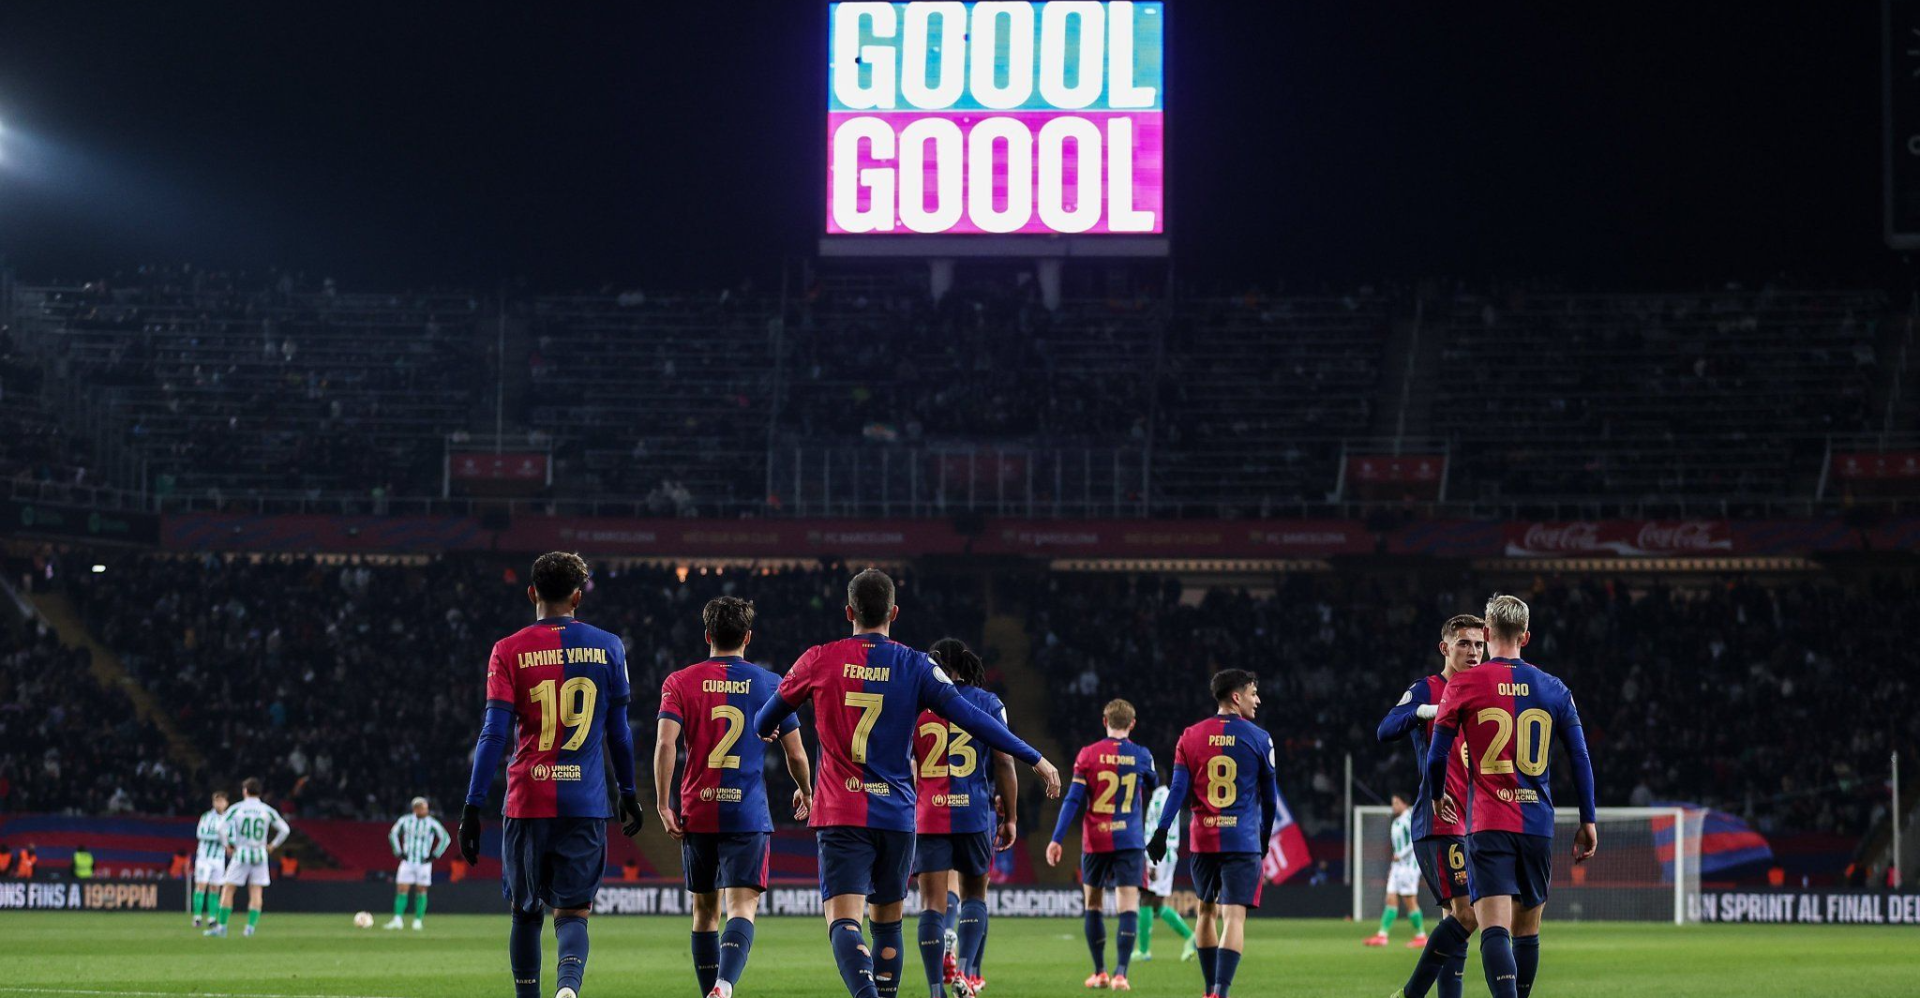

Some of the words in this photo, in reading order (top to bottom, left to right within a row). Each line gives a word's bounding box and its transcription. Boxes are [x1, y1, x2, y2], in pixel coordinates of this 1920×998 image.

[834, 1, 1156, 109] GOOOL
[833, 117, 1155, 233] GOOOL
[518, 649, 564, 669] LAMINE
[566, 648, 608, 665] YAMAL
[702, 679, 752, 694] CUBARSÍ
[843, 664, 890, 682] FERRAN
[1498, 683, 1529, 696] OLMO
[529, 677, 597, 751] 19
[845, 691, 884, 764] 7
[708, 705, 745, 769] 2
[919, 722, 977, 778] 23
[1209, 735, 1235, 746] PEDRI
[1477, 708, 1553, 776] 20
[551, 764, 581, 772] UNHCR
[1207, 755, 1237, 808] 8
[1093, 770, 1136, 813] 21
[241, 817, 265, 841] 46
[1449, 843, 1465, 869] 6
[28, 883, 66, 909] FINS
[68, 884, 81, 908] A
[594, 887, 660, 914] SPRINT
[660, 888, 682, 914] AL
[772, 888, 824, 915] PARTI
[1688, 893, 1717, 922] UN
[1721, 893, 1795, 922] SPRINT
[1798, 894, 1823, 922] AL
[1827, 894, 1884, 922] FINAL
